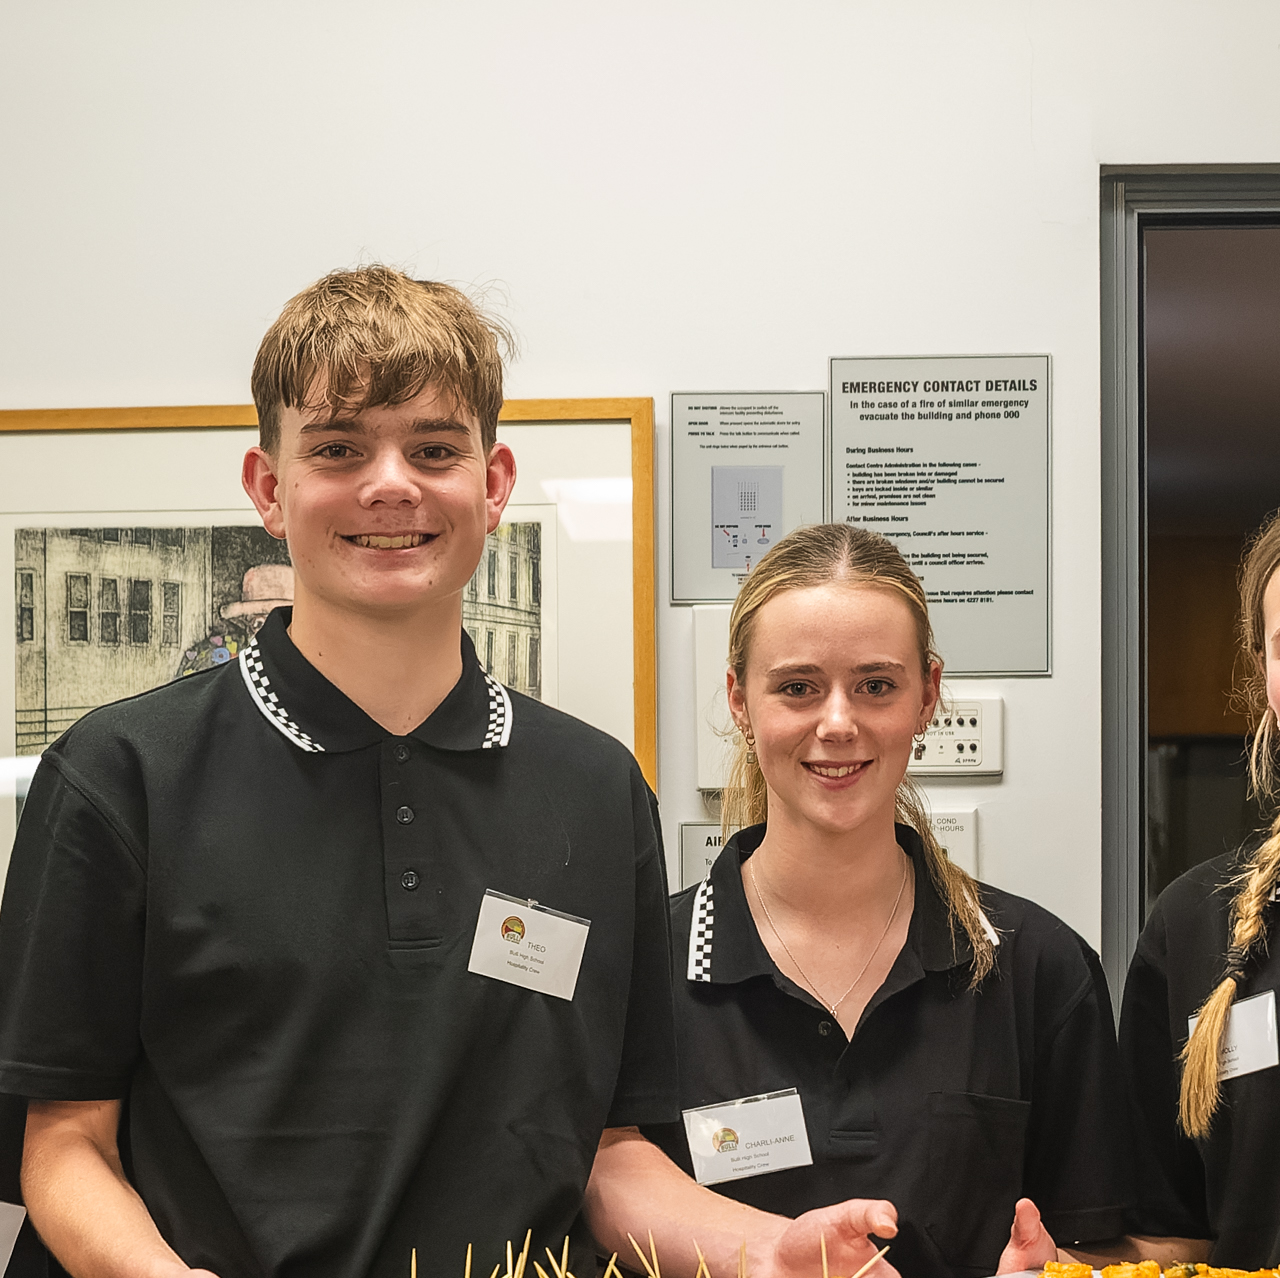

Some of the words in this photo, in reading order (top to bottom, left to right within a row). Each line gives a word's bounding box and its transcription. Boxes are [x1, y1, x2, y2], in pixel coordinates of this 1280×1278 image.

[842, 381, 919, 394] EMERGENCY
[923, 380, 981, 392] CONTACT
[986, 379, 1038, 392] DETAILS
[850, 400, 858, 408] In
[861, 400, 875, 408] the
[900, 400, 909, 408] of
[920, 400, 934, 408] fire
[937, 400, 946, 408] of
[948, 399, 978, 408] similar
[981, 400, 1029, 409] emergency
[860, 412, 898, 420] evacuate
[901, 412, 915, 420] the
[918, 412, 953, 422] building
[956, 412, 972, 420] and
[974, 411, 1001, 421] phone
[1004, 411, 1020, 419] 000
[705, 858, 712, 866] To
[528, 942, 546, 953] THEO
[745, 1135, 795, 1149] CHARLI-ANNE
